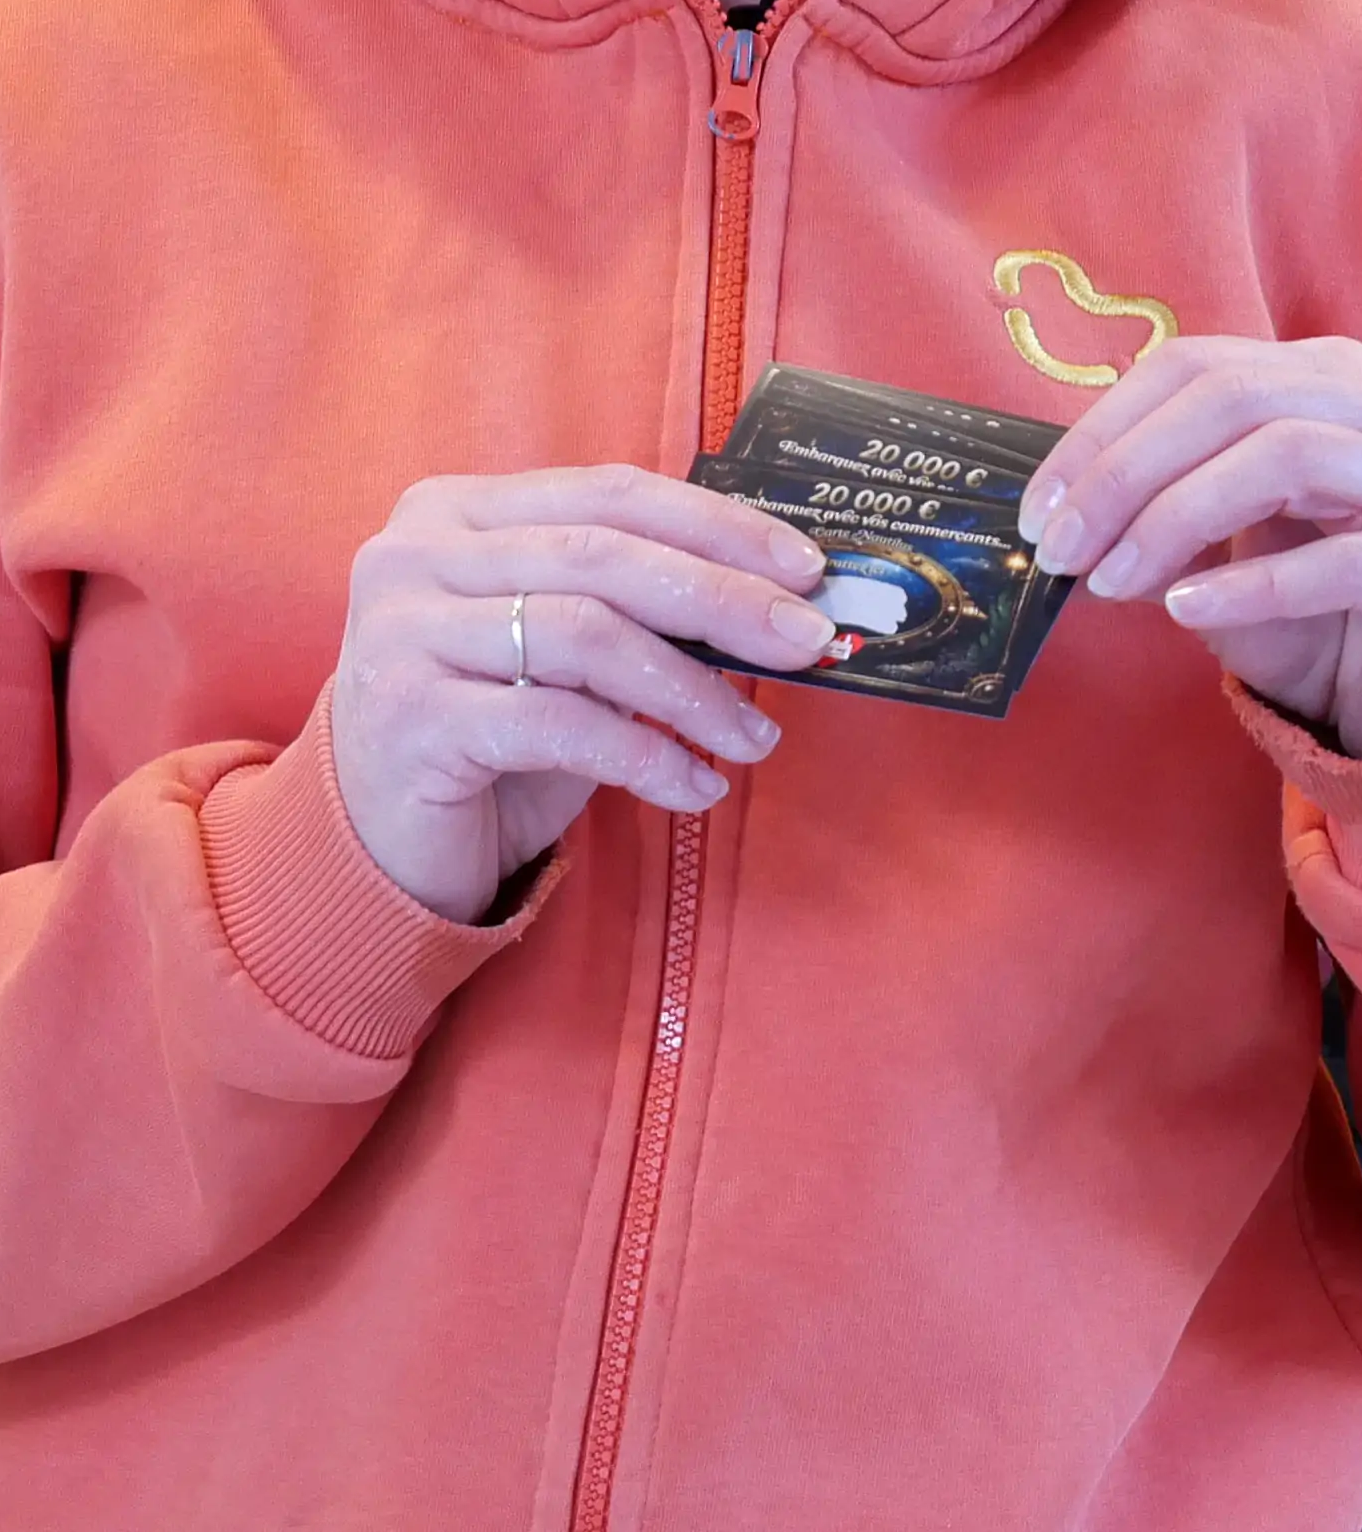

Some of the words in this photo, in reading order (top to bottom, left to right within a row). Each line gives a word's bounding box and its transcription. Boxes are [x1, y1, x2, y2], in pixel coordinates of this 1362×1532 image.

[778, 439, 870, 477] Embarquez
[870, 466, 907, 484] avec
[858, 439, 901, 463] 20
[903, 450, 962, 480] 000
[964, 468, 989, 489] €
[807, 482, 850, 506] 20
[853, 489, 913, 516] 000
[919, 500, 941, 520] €
[823, 509, 860, 524] avec
[861, 513, 889, 529] vos
